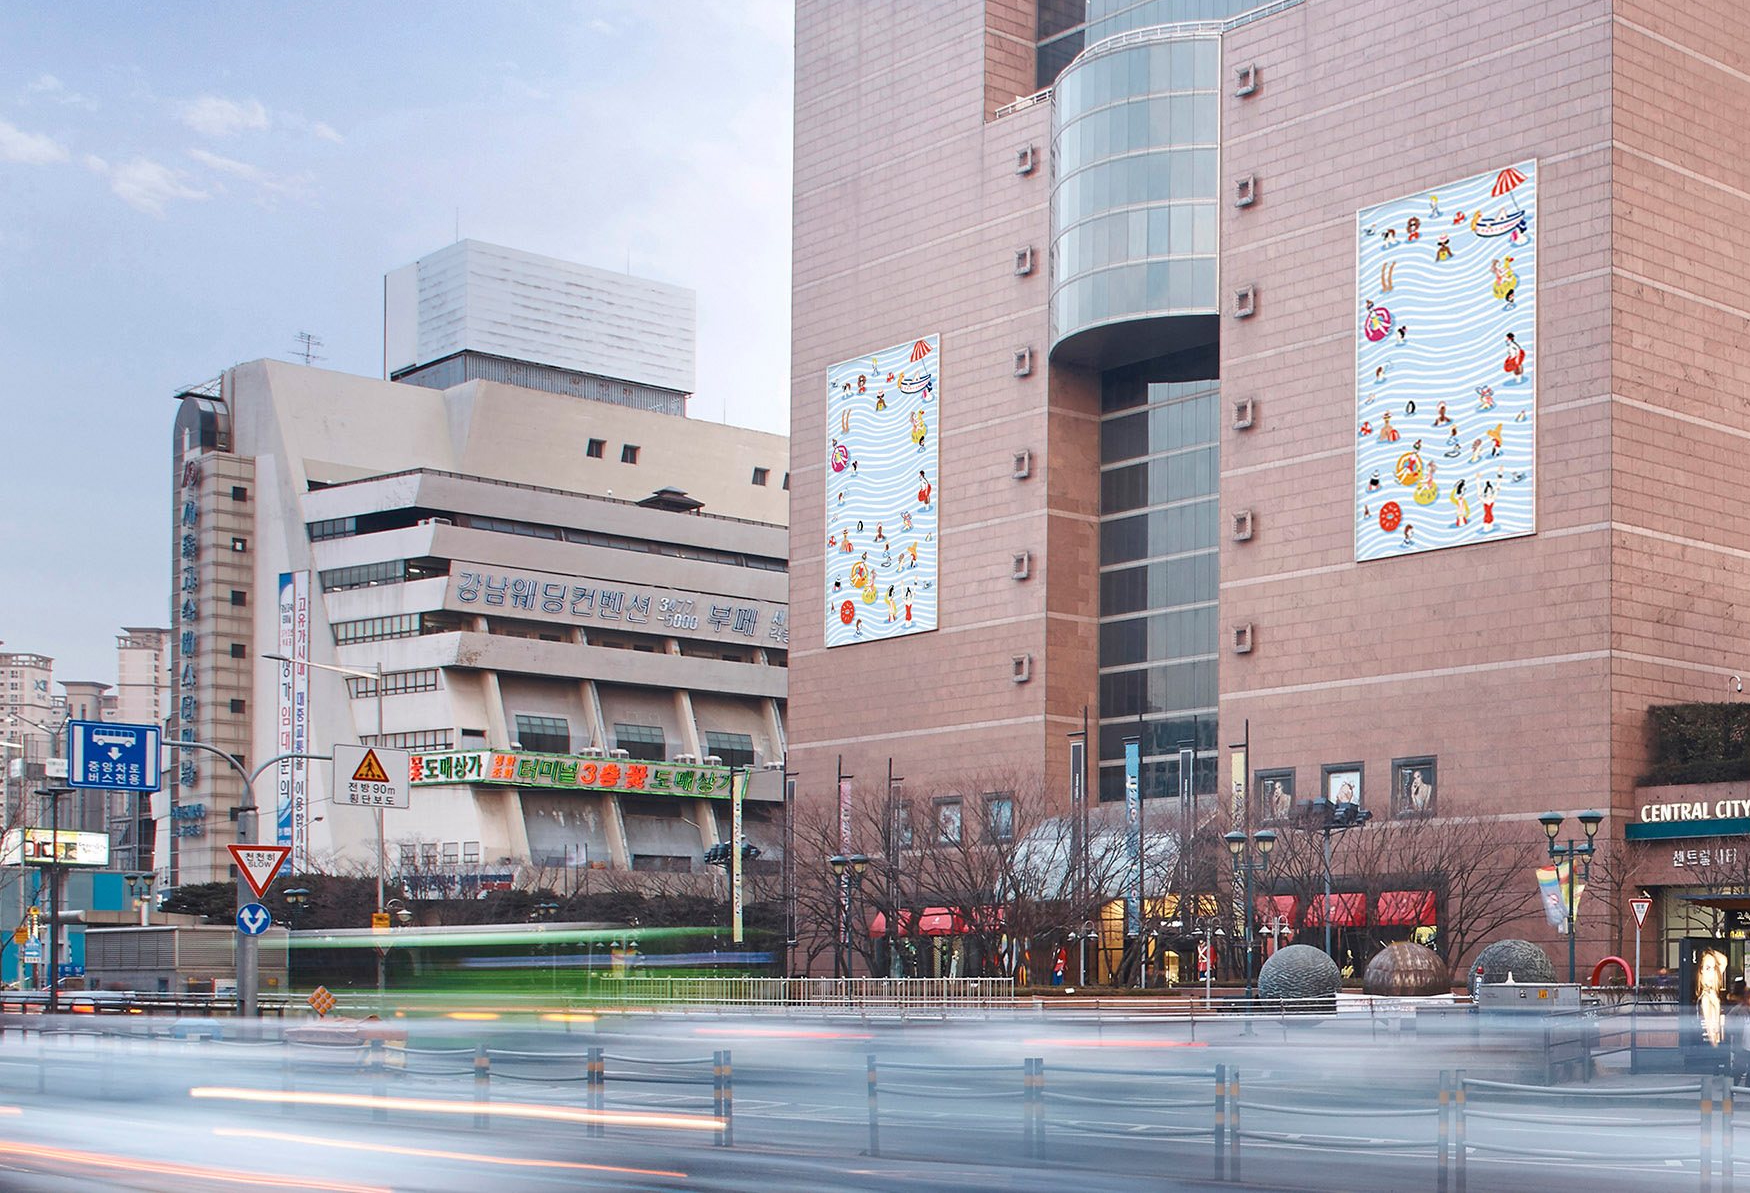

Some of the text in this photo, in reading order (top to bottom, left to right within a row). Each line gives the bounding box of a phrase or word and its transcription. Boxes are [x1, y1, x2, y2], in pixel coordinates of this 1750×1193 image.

[456, 570, 653, 625] 강남웨딩컨벤션
[87, 760, 141, 774] 중앙차로
[87, 772, 141, 786] 버스전용
[372, 783, 396, 795] 90m
[1640, 801, 1712, 823] CENTRAL
